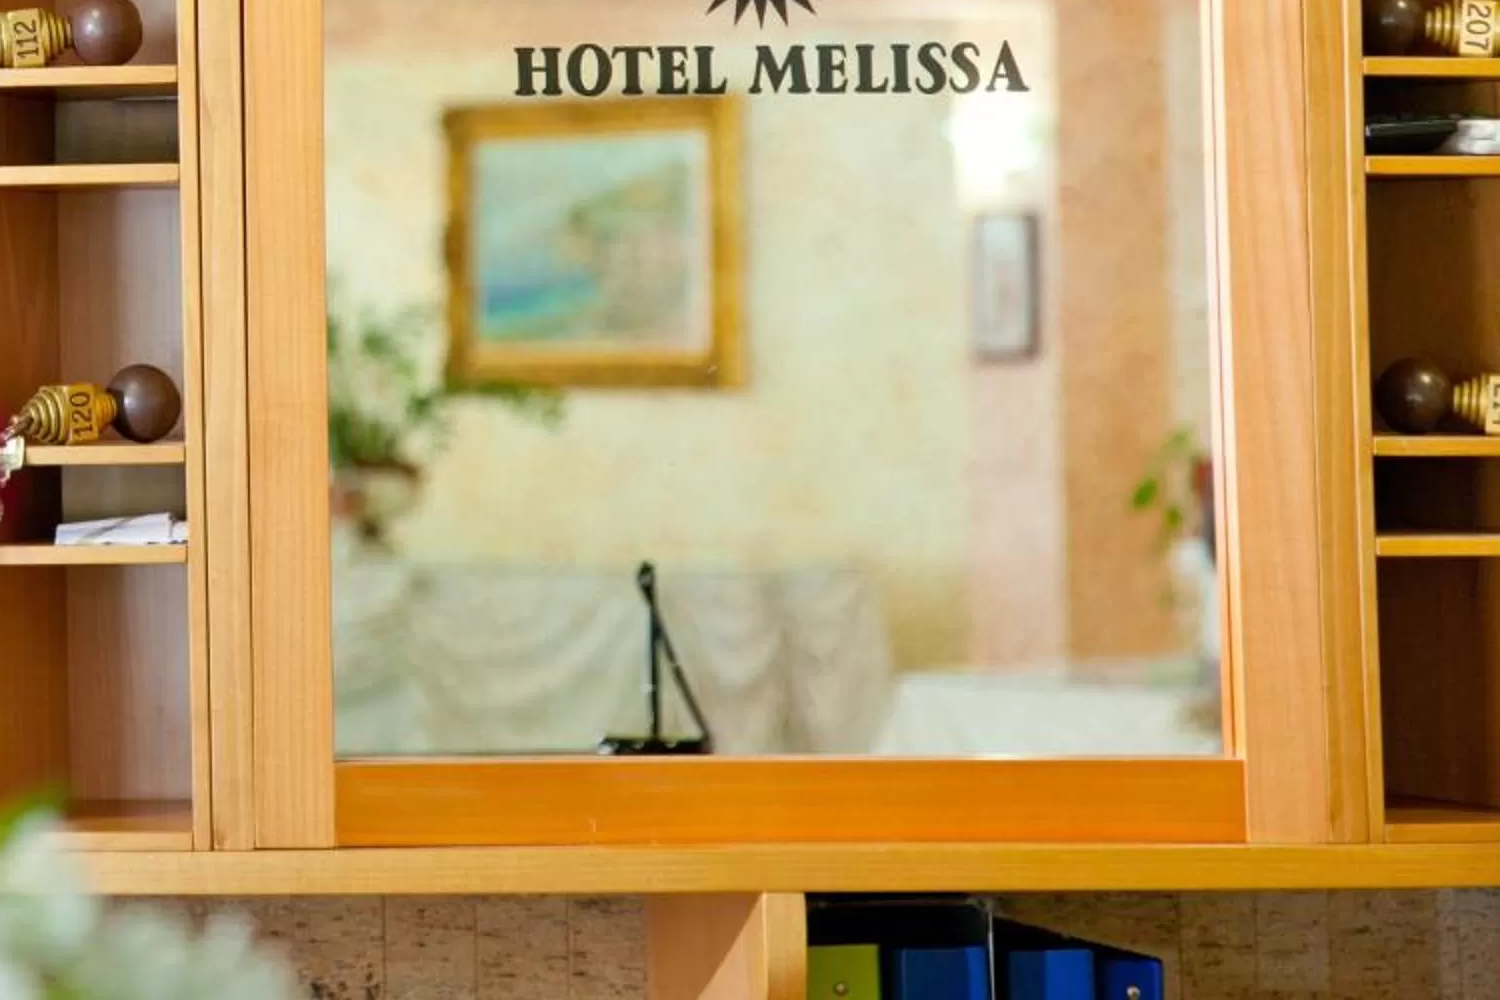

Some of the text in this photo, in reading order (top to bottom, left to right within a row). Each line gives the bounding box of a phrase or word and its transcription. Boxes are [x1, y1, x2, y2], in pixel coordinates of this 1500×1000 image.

[13, 20, 39, 59] 112
[1465, 3, 1492, 50] 207
[514, 40, 1031, 96] HOTEL MELISSA
[70, 390, 94, 440] 120
